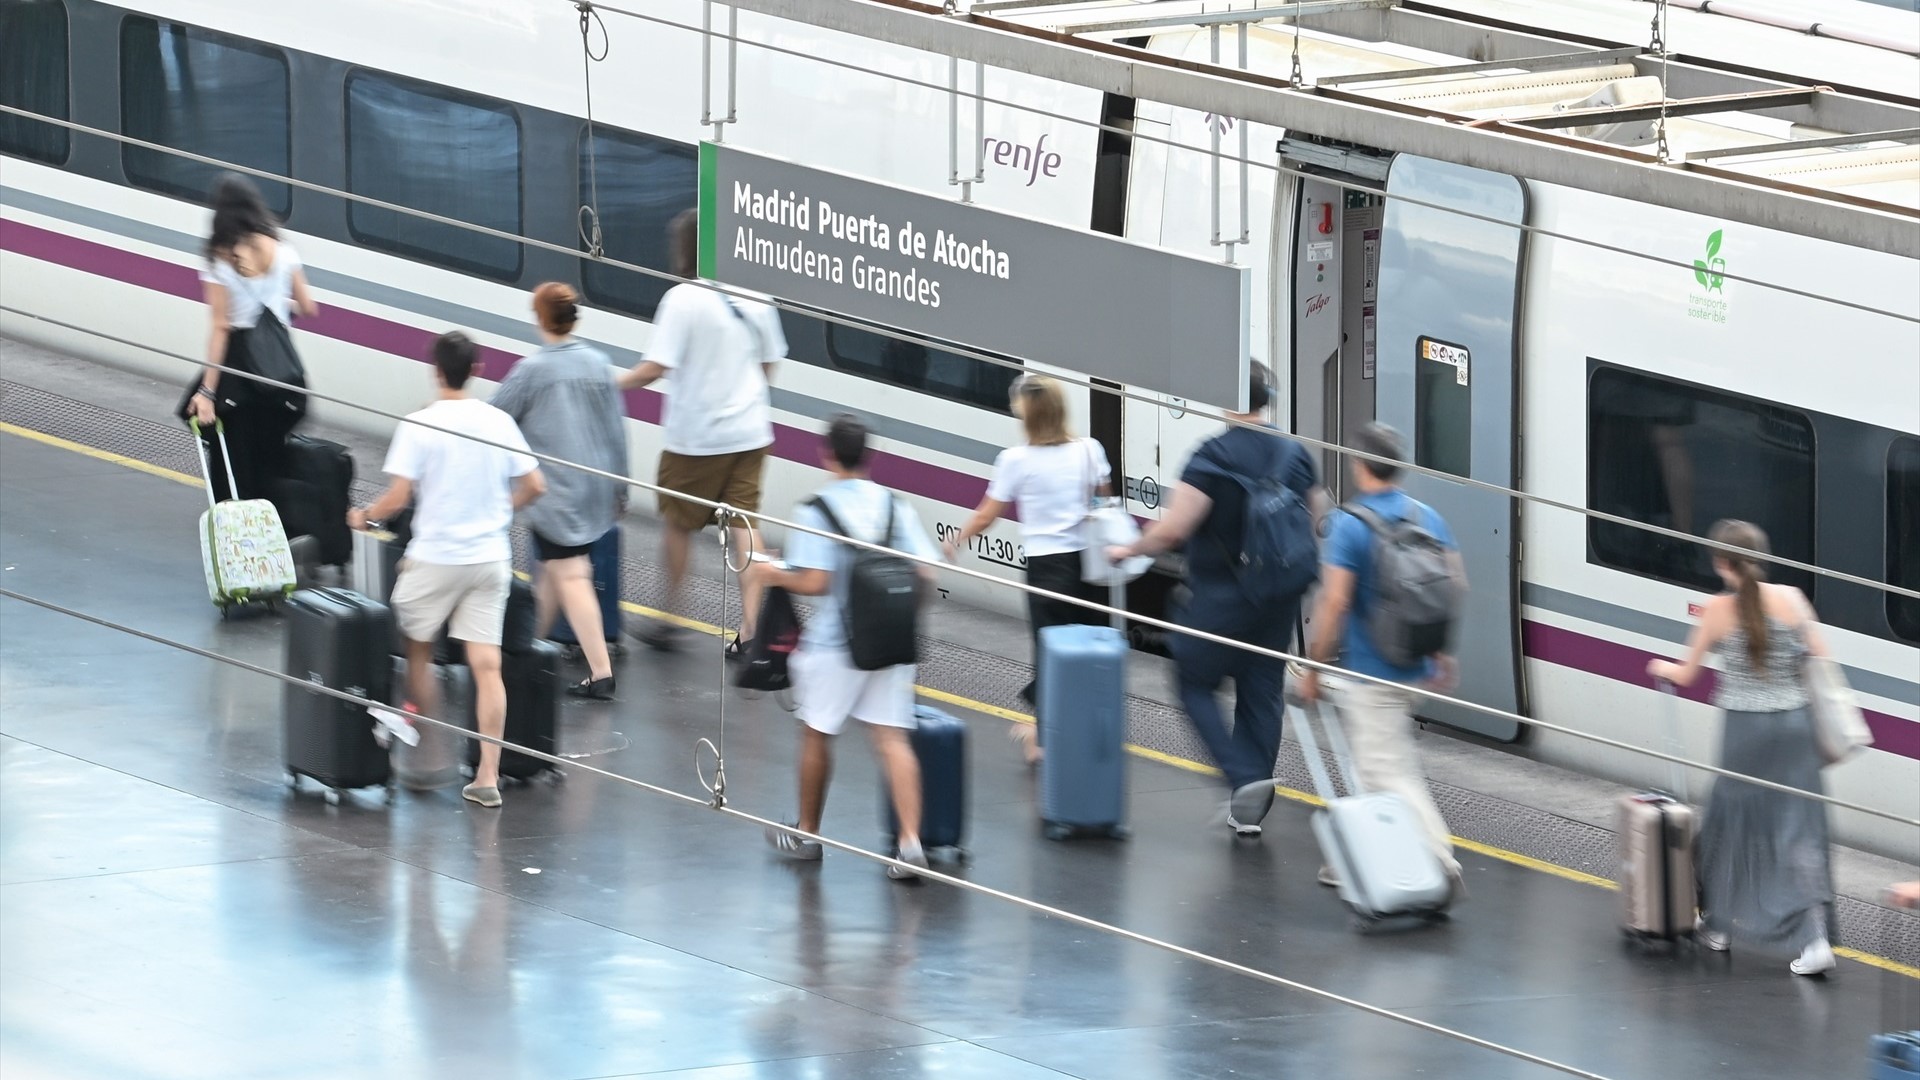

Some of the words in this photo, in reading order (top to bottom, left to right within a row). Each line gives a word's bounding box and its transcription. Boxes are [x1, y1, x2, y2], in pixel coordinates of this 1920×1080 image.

[984, 133, 1062, 187] renfe
[733, 180, 810, 231] Madrid
[818, 200, 890, 251] Puerta
[898, 220, 927, 259] de
[932, 229, 1010, 280] Atocha
[733, 225, 843, 284] Almudena
[852, 254, 941, 308] Grandes
[1305, 293, 1331, 318] Talgo
[1689, 293, 1727, 311] transporte
